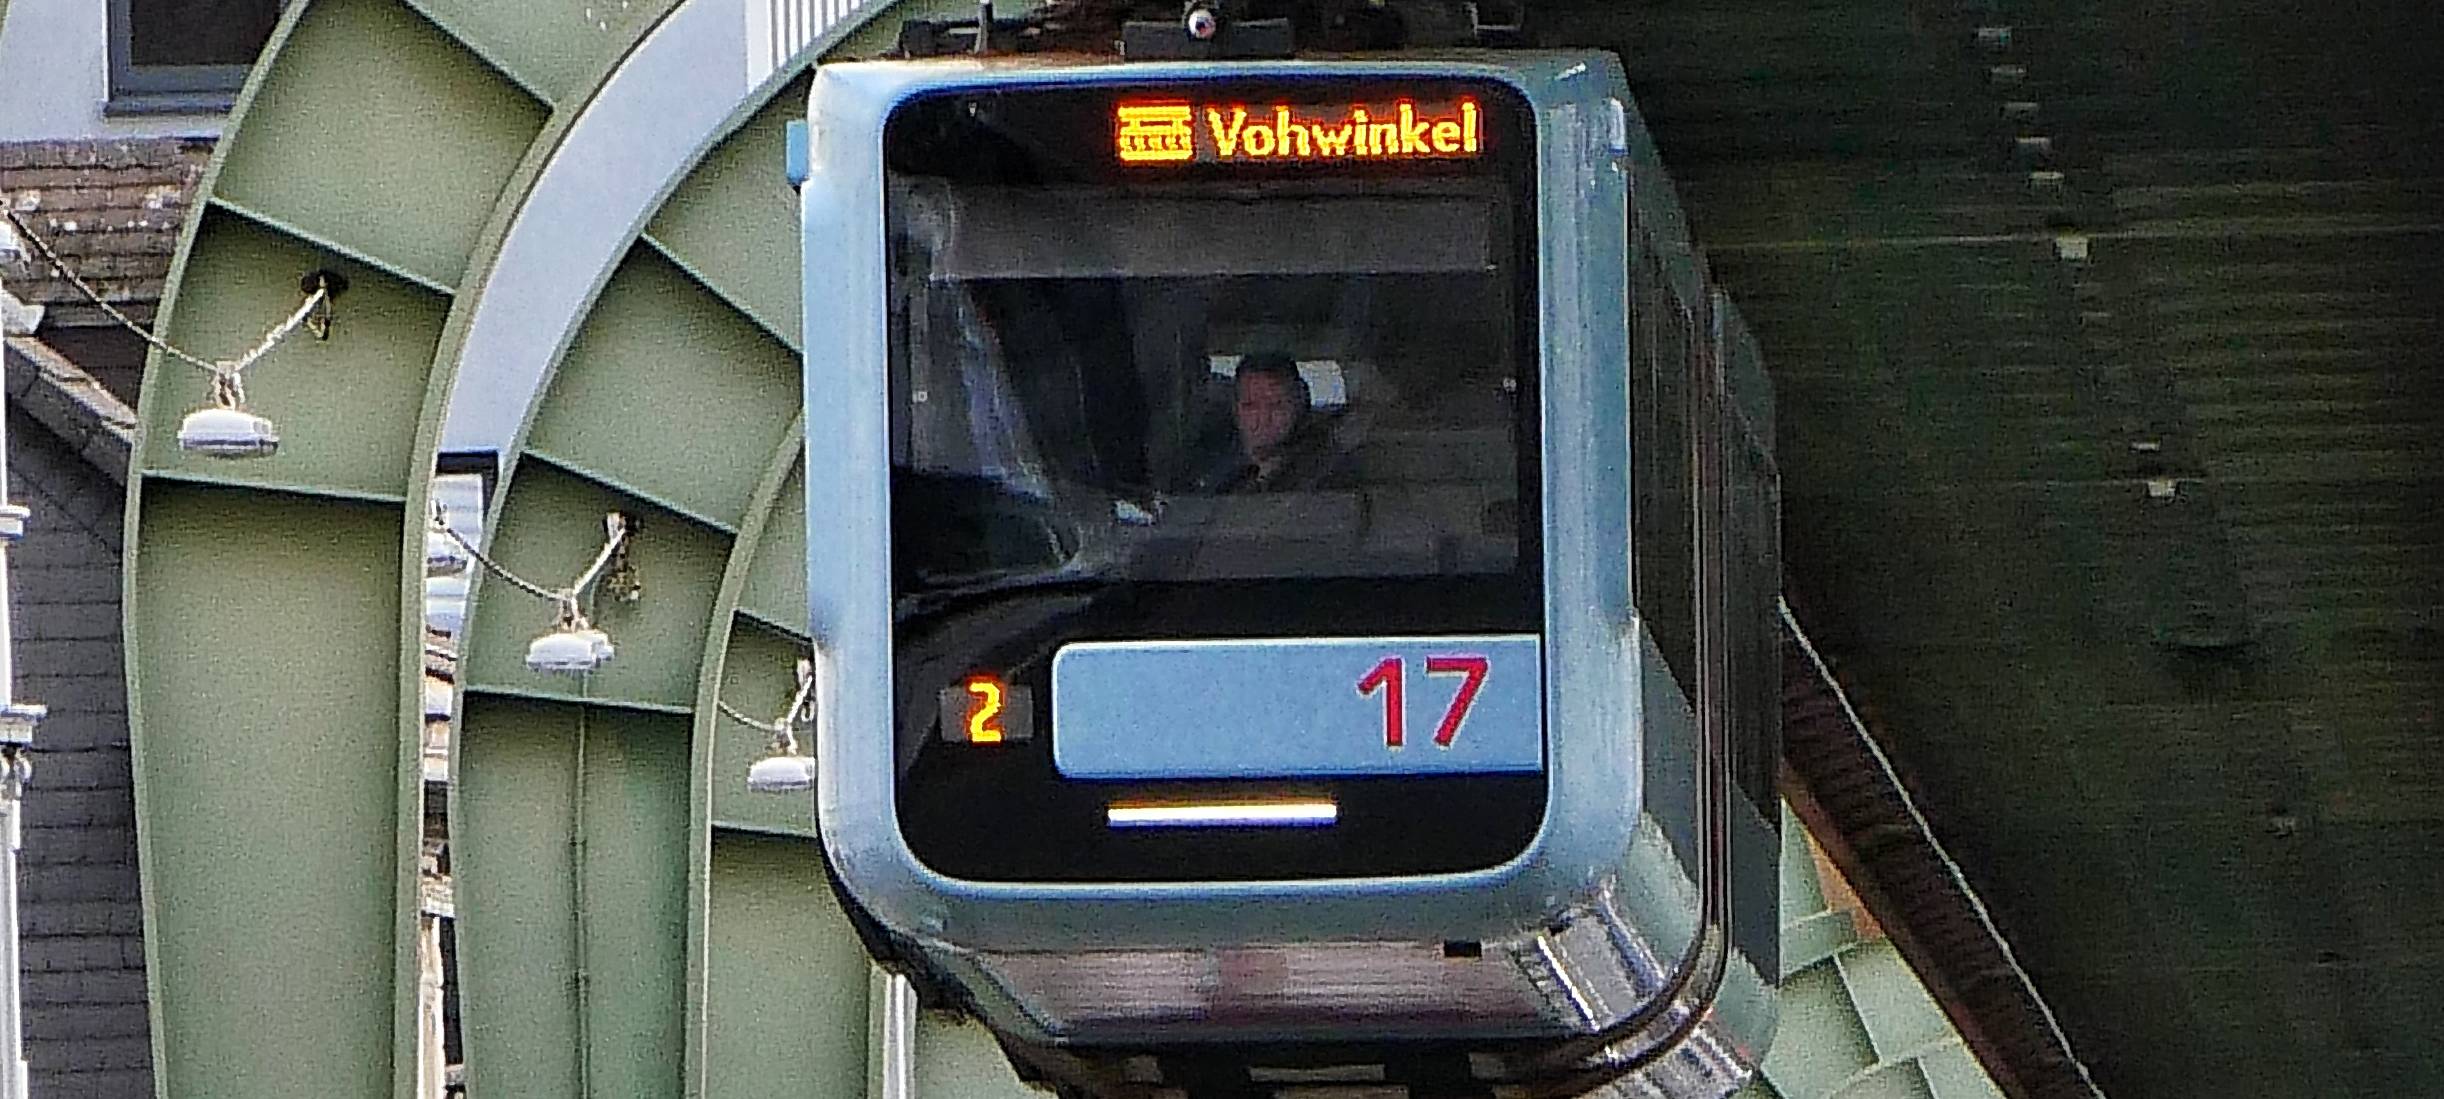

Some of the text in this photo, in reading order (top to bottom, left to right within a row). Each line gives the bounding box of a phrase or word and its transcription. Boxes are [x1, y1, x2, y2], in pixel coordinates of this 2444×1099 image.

[1207, 100, 1479, 157] Vohwinkel
[965, 679, 1003, 743] 2
[1357, 656, 1489, 748] 17
